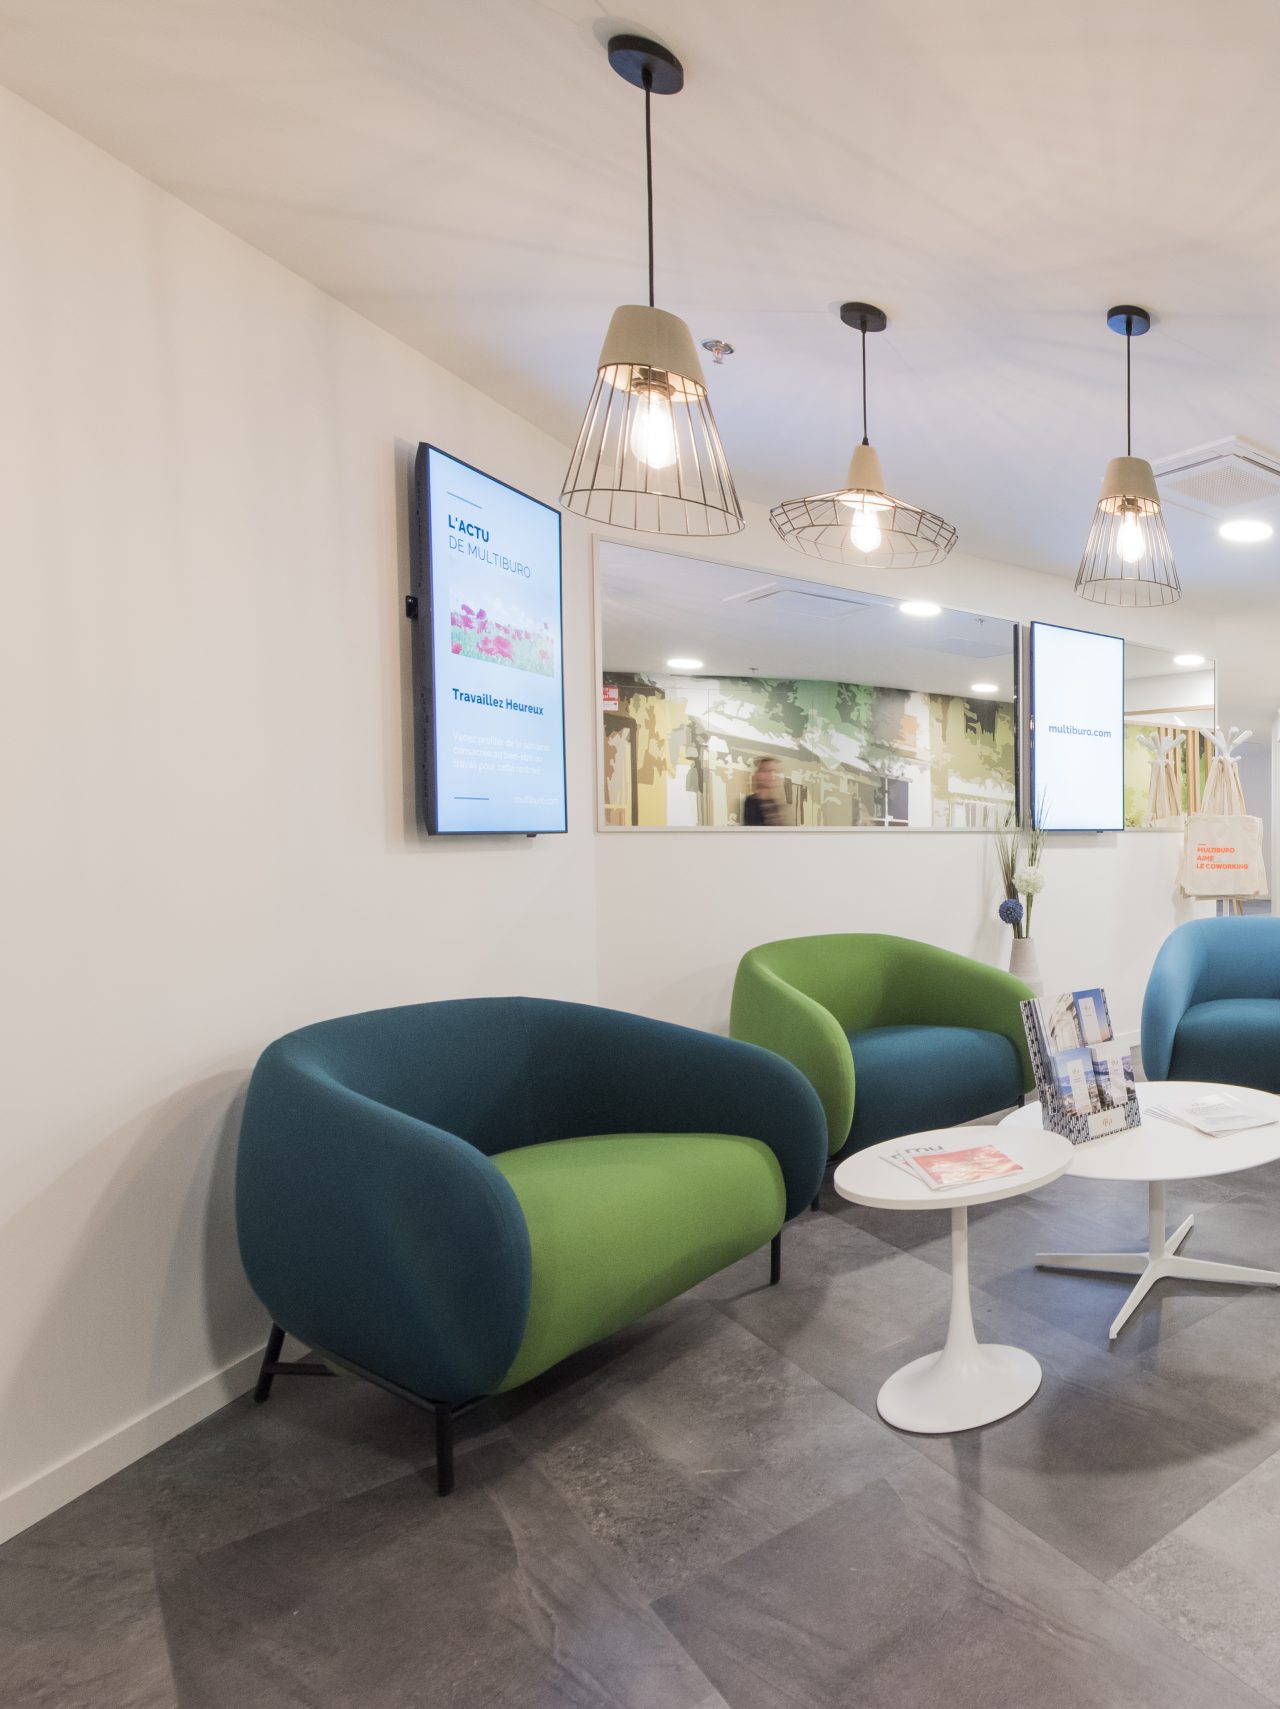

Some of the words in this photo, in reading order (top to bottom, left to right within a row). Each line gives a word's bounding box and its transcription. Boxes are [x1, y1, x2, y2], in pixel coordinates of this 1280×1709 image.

[448, 514, 490, 543] L'ACTU
[449, 535, 465, 553] DE
[468, 543, 531, 578] MULTIBURO
[452, 688, 504, 709] Travaillez
[505, 698, 544, 715] Heureux
[1048, 724, 1112, 738] multiburo.com
